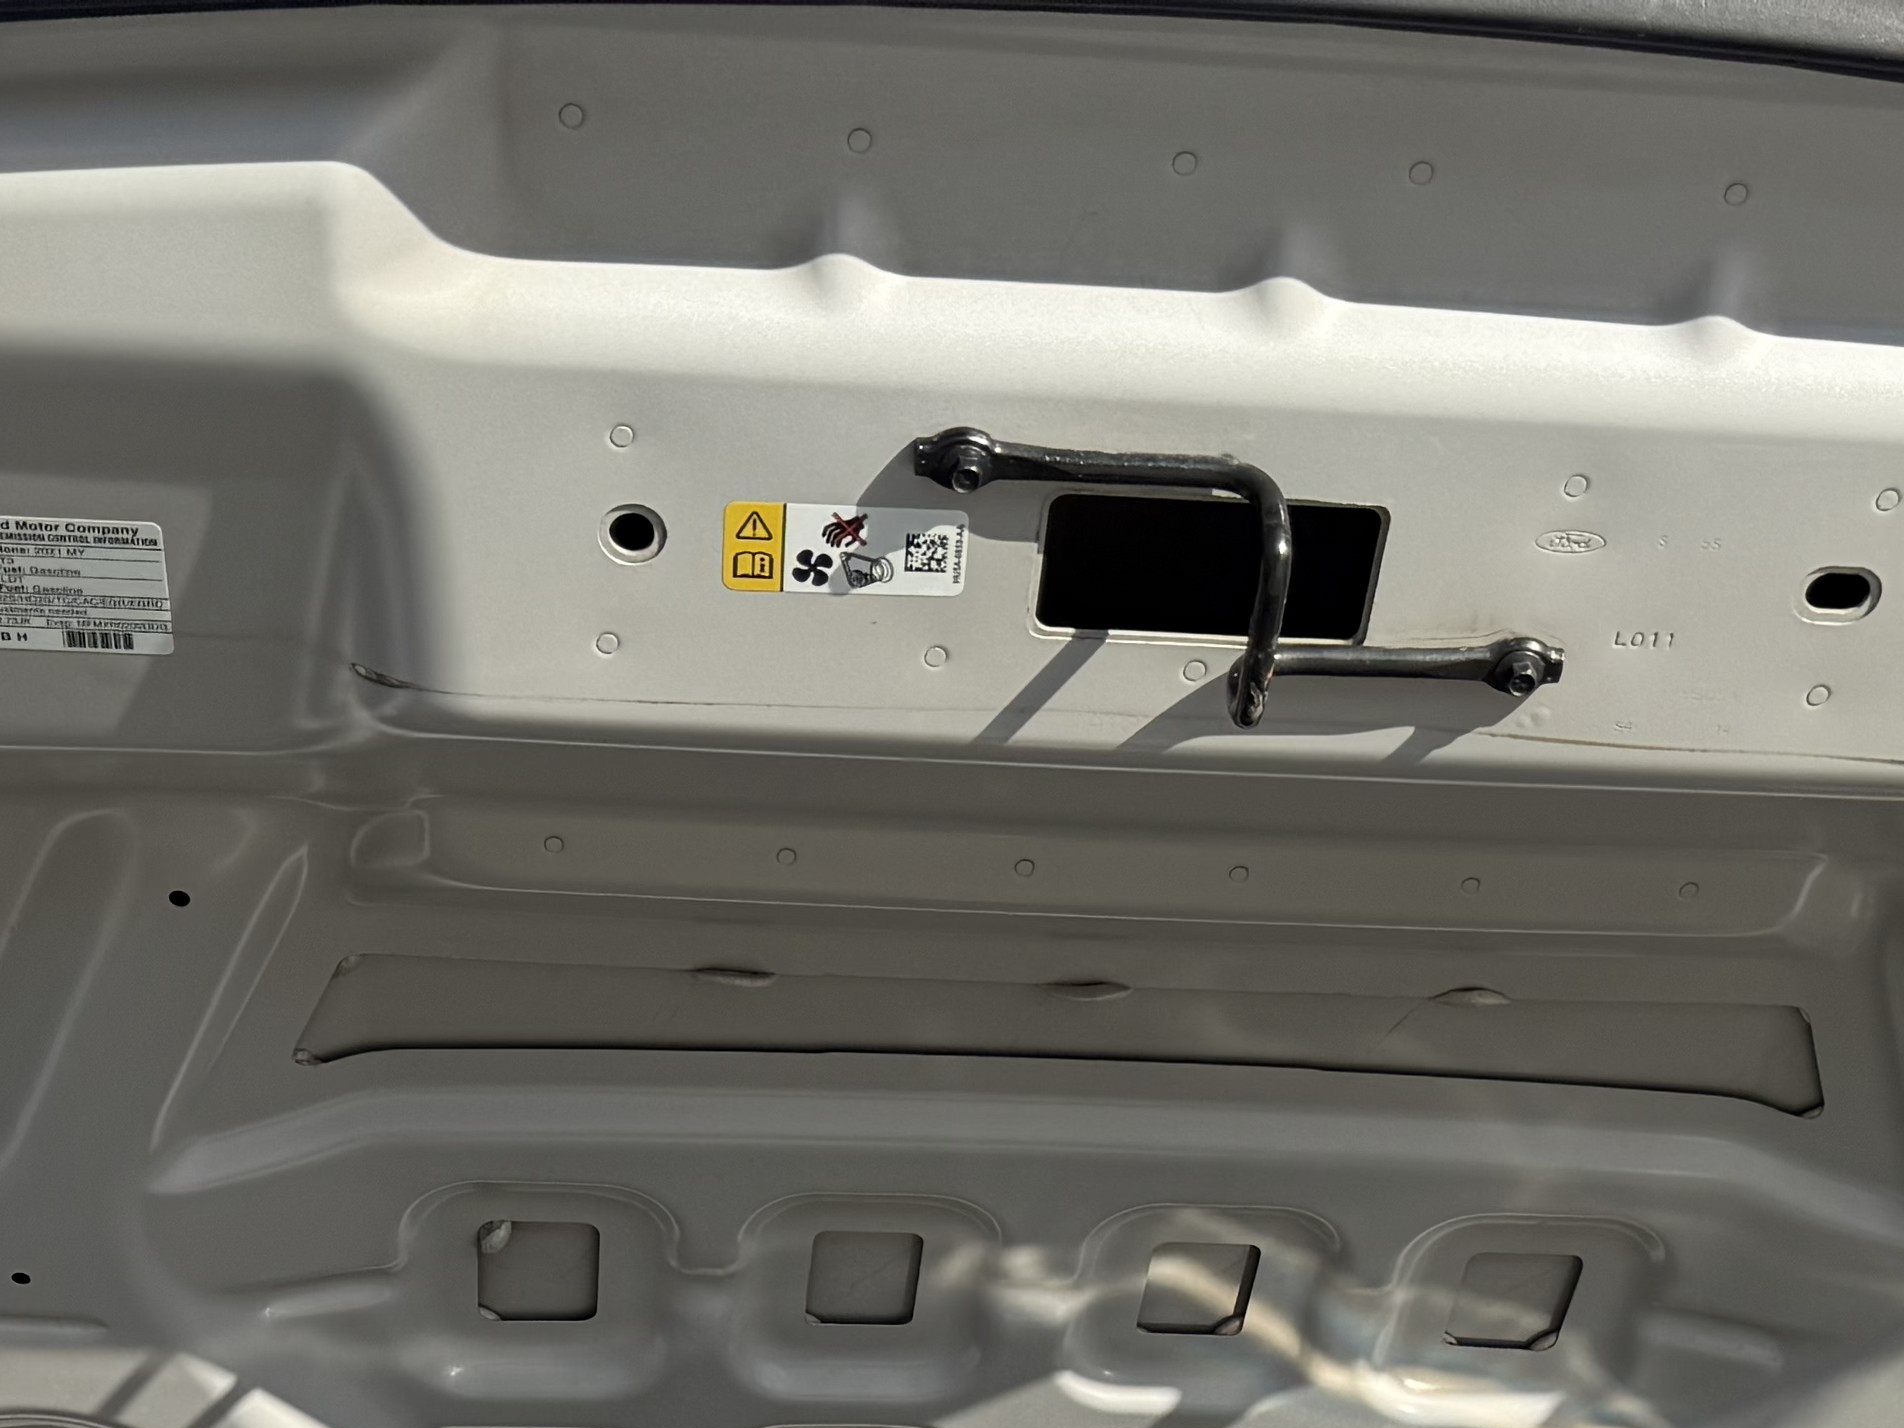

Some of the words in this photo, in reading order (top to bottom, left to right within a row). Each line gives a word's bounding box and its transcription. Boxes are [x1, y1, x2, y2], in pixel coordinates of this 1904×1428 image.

[14, 519, 61, 532] Motor
[64, 522, 139, 538] Company
[65, 548, 85, 557] MY
